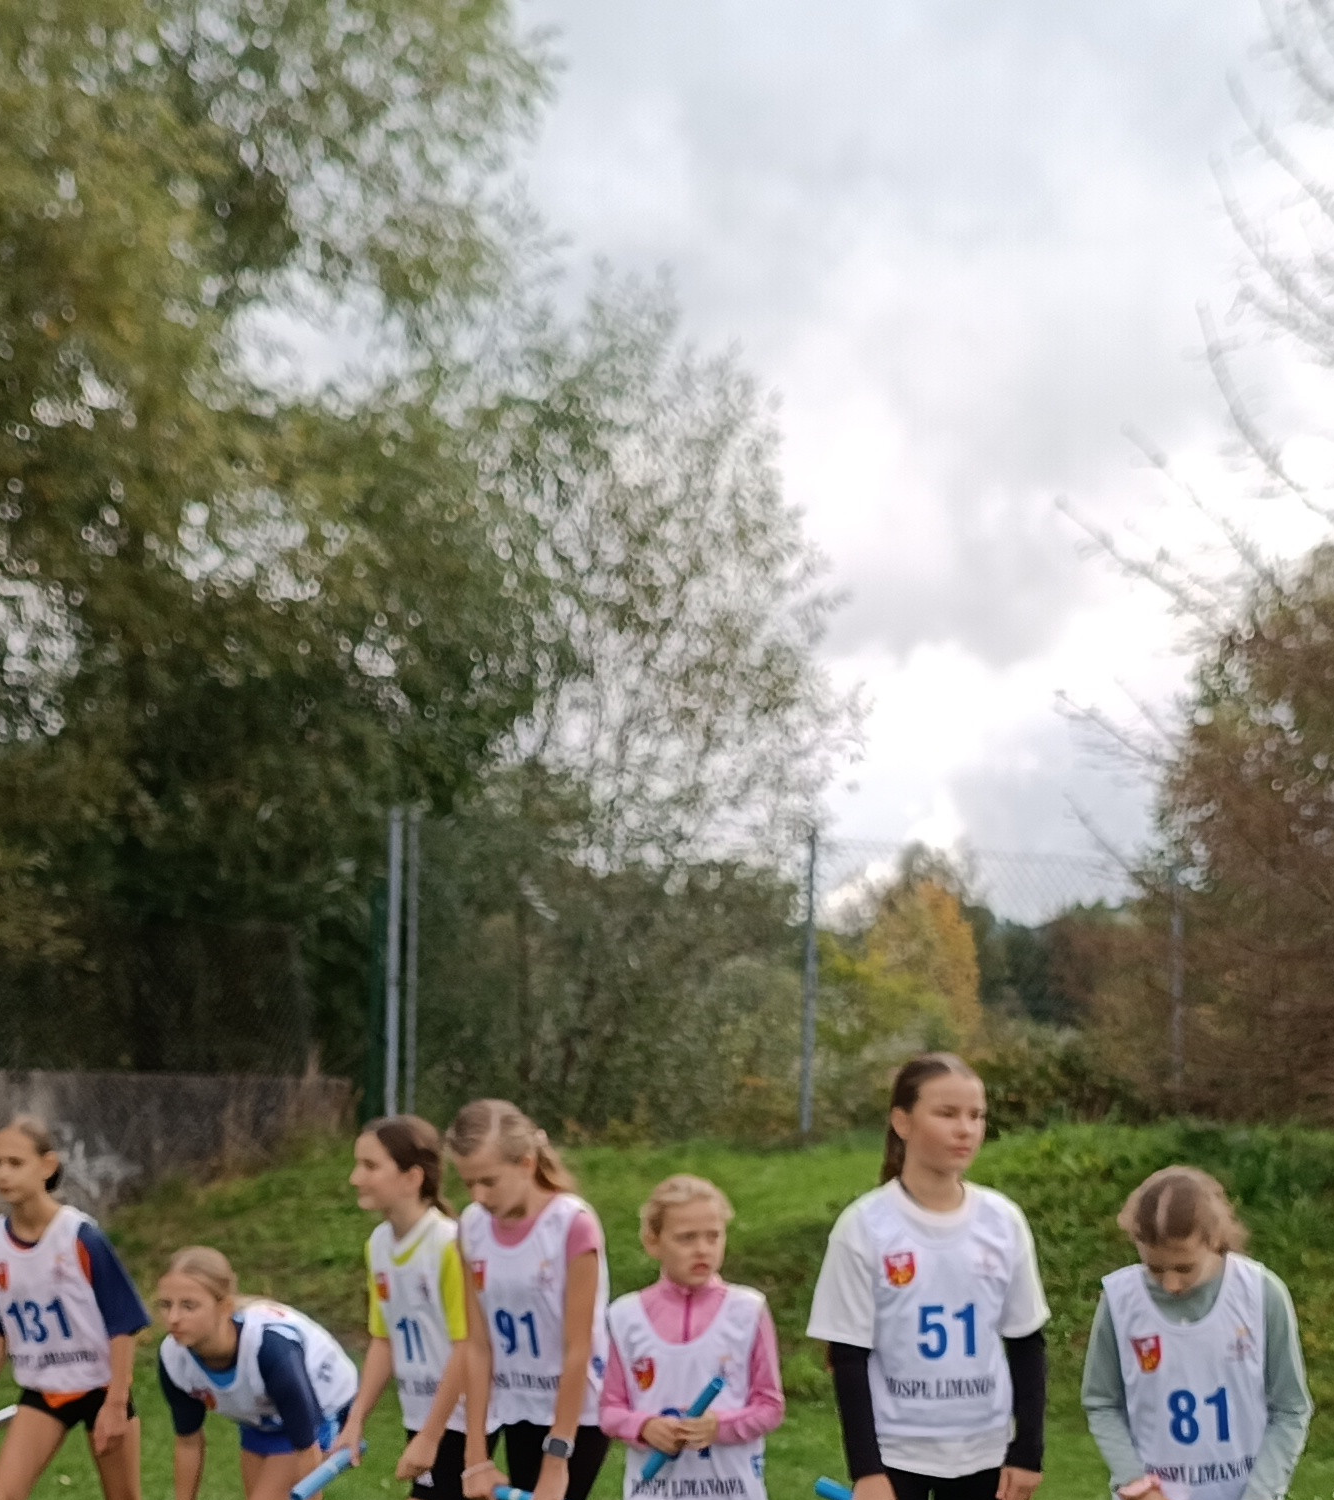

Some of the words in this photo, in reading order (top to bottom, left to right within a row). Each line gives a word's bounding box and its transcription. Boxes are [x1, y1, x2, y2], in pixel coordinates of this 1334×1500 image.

[6, 1297, 72, 1343] 131
[396, 1317, 427, 1364] 11
[495, 1309, 540, 1357] 91
[917, 1302, 976, 1360] 51
[1168, 1386, 1230, 1445] 81
